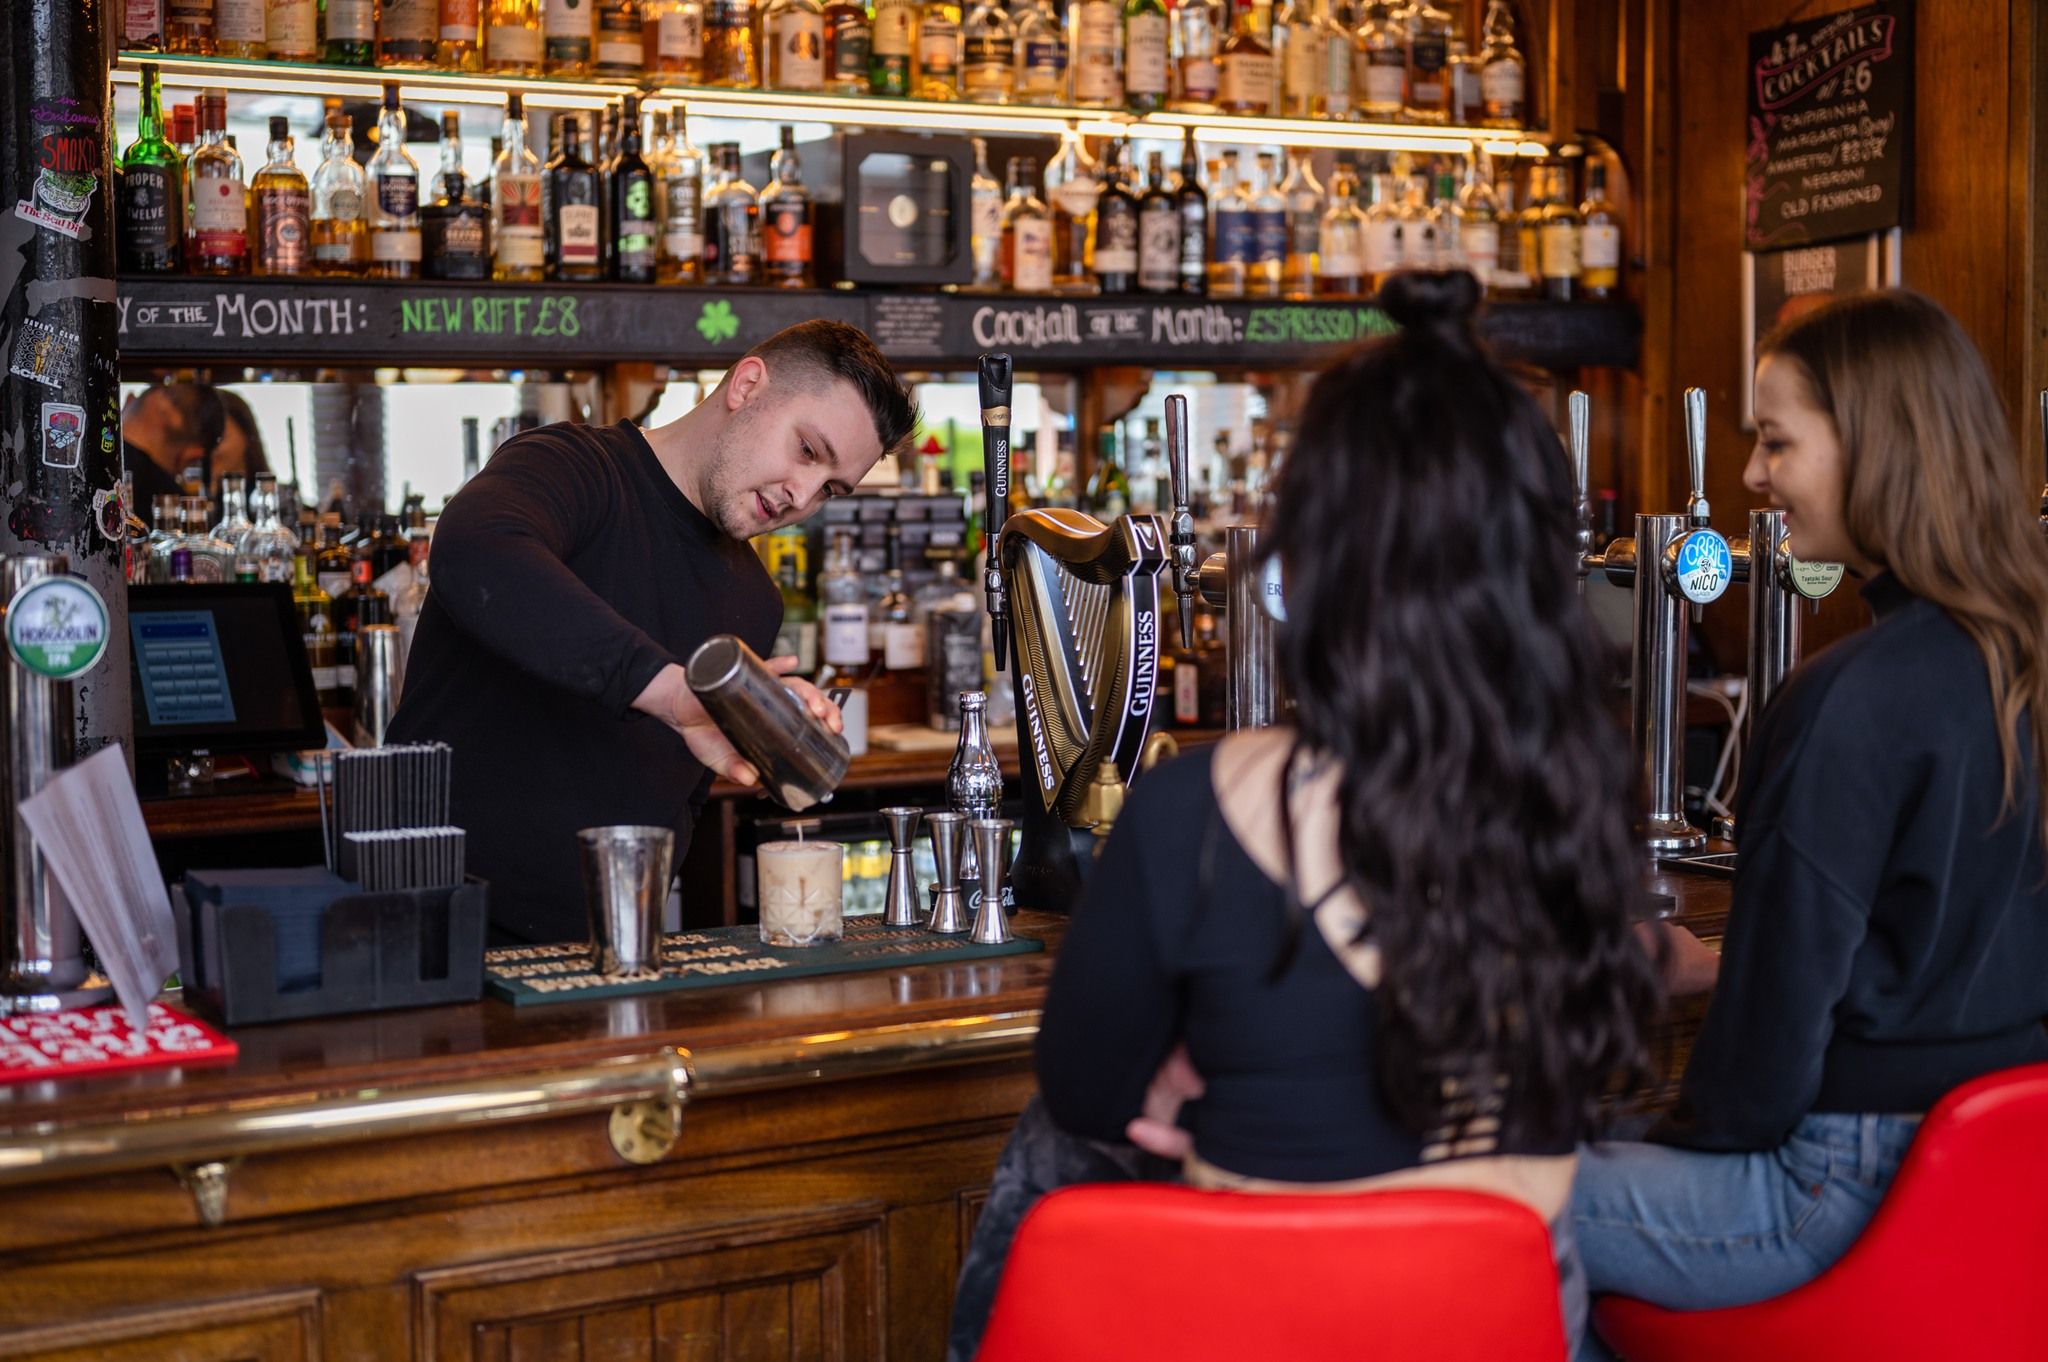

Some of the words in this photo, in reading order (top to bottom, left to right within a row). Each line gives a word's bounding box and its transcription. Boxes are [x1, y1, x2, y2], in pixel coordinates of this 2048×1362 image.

[1764, 19, 1883, 101] COCKTAILS
[1841, 59, 1873, 96] £6
[125, 172, 164, 190] PROPER
[127, 205, 165, 221] TWELVE
[1781, 198, 1809, 219] OLD
[1811, 184, 1882, 213] FASHIONED
[24, 318, 54, 333] HAVANA
[137, 307, 159, 323] OF
[169, 306, 208, 323] THE
[213, 293, 368, 338] MONTH:
[401, 298, 462, 333] NEW
[470, 297, 532, 335] RIFF
[532, 296, 581, 336] £8
[972, 303, 1082, 348] Cocktail
[1151, 305, 1243, 345] Month:
[1245, 307, 1354, 343] ESPRESSO
[9, 364, 62, 390] &CHILL
[995, 439, 1007, 498] GUINNESS
[1690, 573, 1719, 592] NICO
[1130, 610, 1153, 717] GUINNESS
[1022, 673, 1055, 791] GUINNESS
